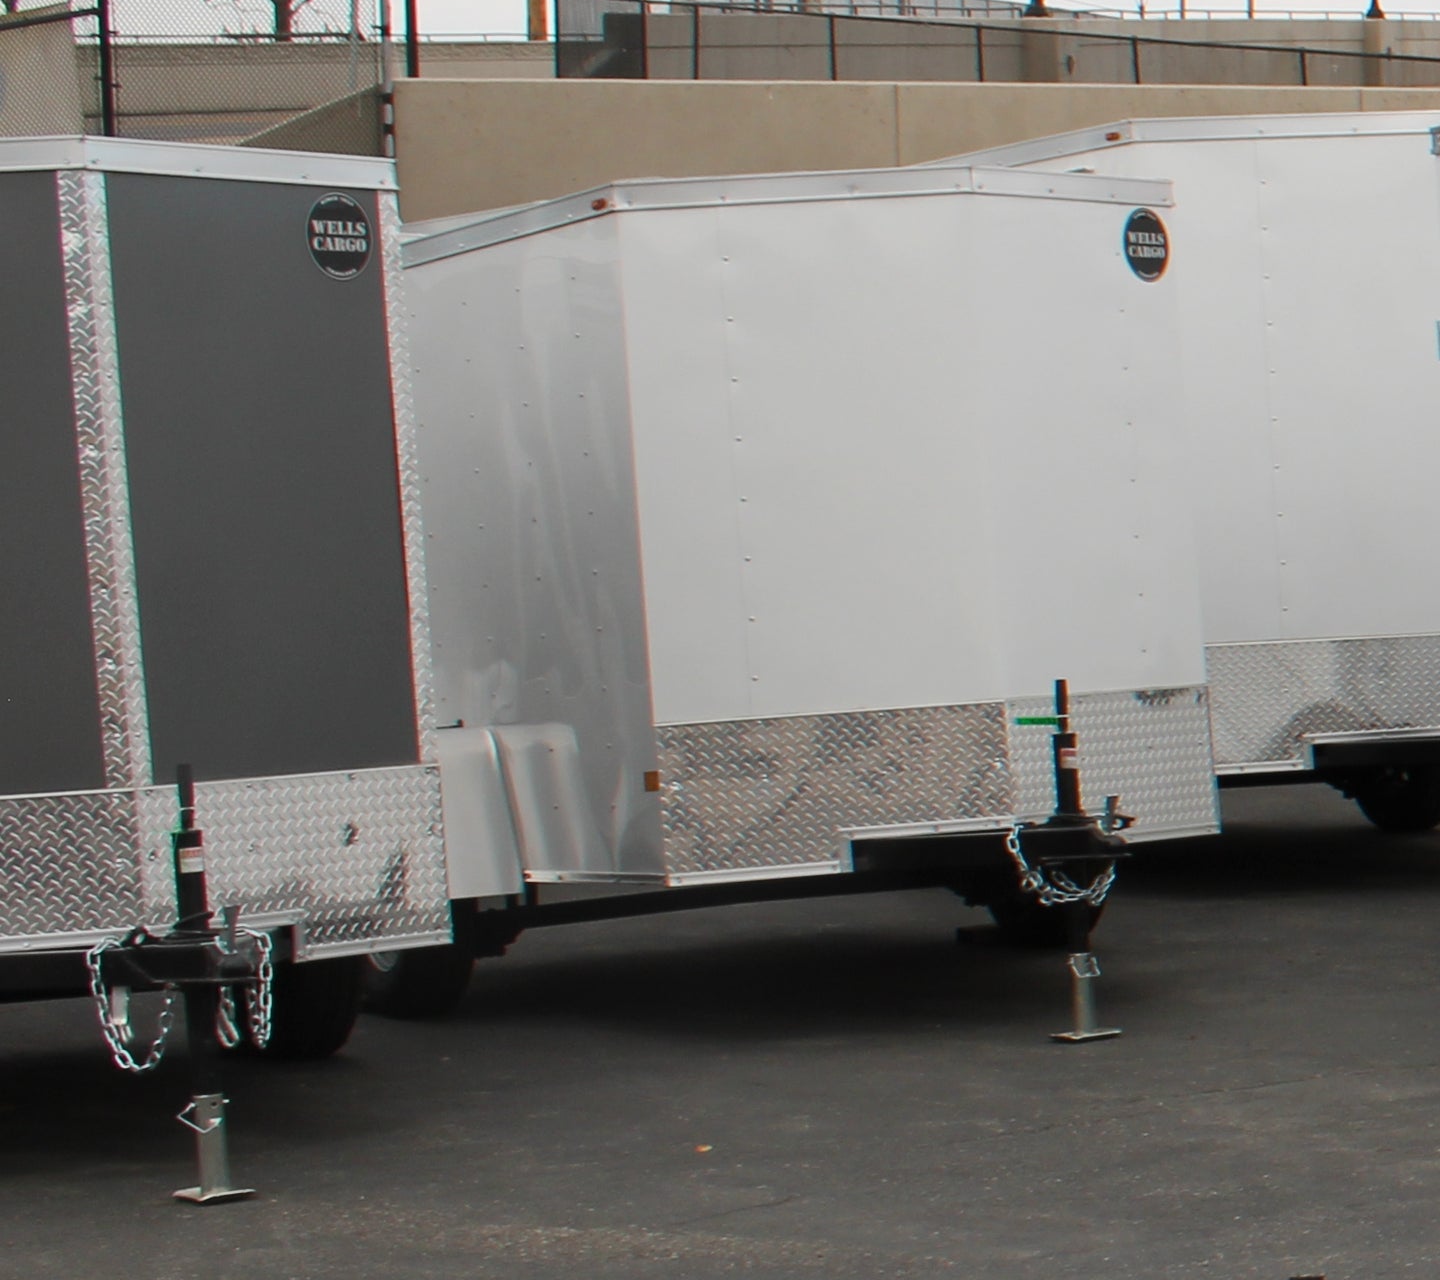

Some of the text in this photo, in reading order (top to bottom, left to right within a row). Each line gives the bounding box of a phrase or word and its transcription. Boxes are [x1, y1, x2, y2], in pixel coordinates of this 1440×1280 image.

[311, 219, 366, 236] WELLS
[312, 236, 368, 252] CARGO
[1128, 231, 1165, 245] WELLS
[1128, 245, 1166, 258] CARGO
